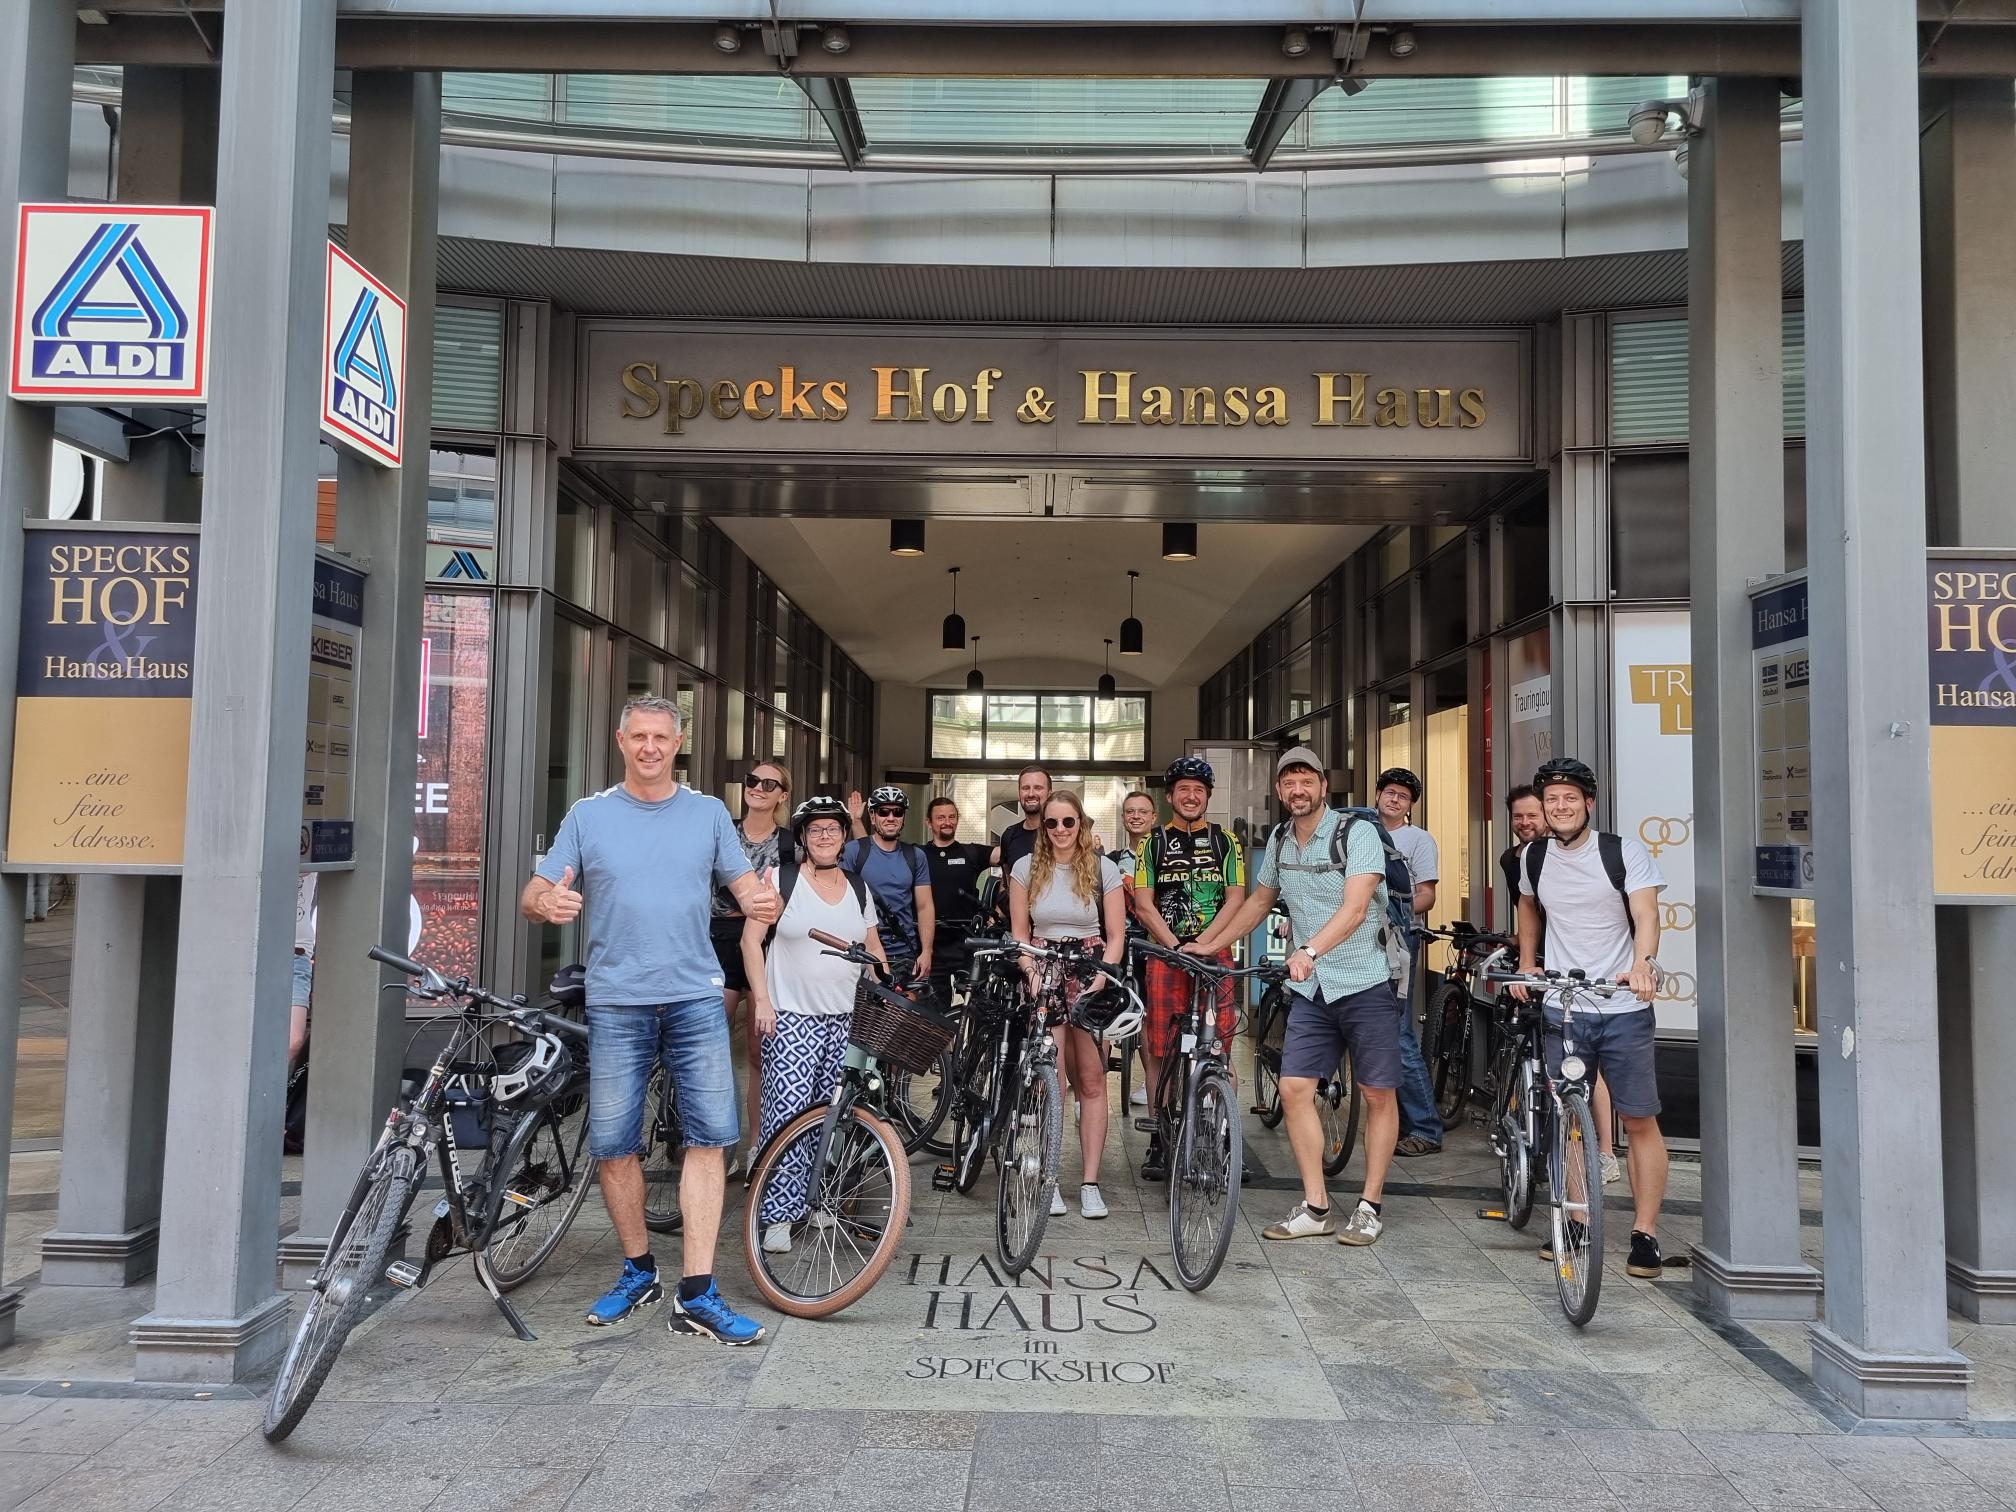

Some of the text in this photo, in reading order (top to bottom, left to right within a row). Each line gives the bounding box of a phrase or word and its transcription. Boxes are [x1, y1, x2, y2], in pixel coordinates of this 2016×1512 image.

[45, 344, 172, 376] ALDI
[621, 361, 1488, 435] Specks Hof & Hansa Haus
[338, 390, 391, 444] ALDI
[49, 545, 190, 574] SPECKS
[47, 576, 190, 626] HOF
[329, 579, 360, 611] Haus
[1758, 606, 1797, 633] Hansa
[311, 638, 353, 662] KIESER
[53, 793, 126, 825] feine
[53, 824, 155, 849] Adresse.
[444, 1112, 463, 1195] corratec
[900, 1253, 1182, 1291] HANSA
[918, 1290, 1157, 1335] HAUS
[1024, 1337, 1059, 1354] im
[906, 1356, 1177, 1384] SPECKSHOF
